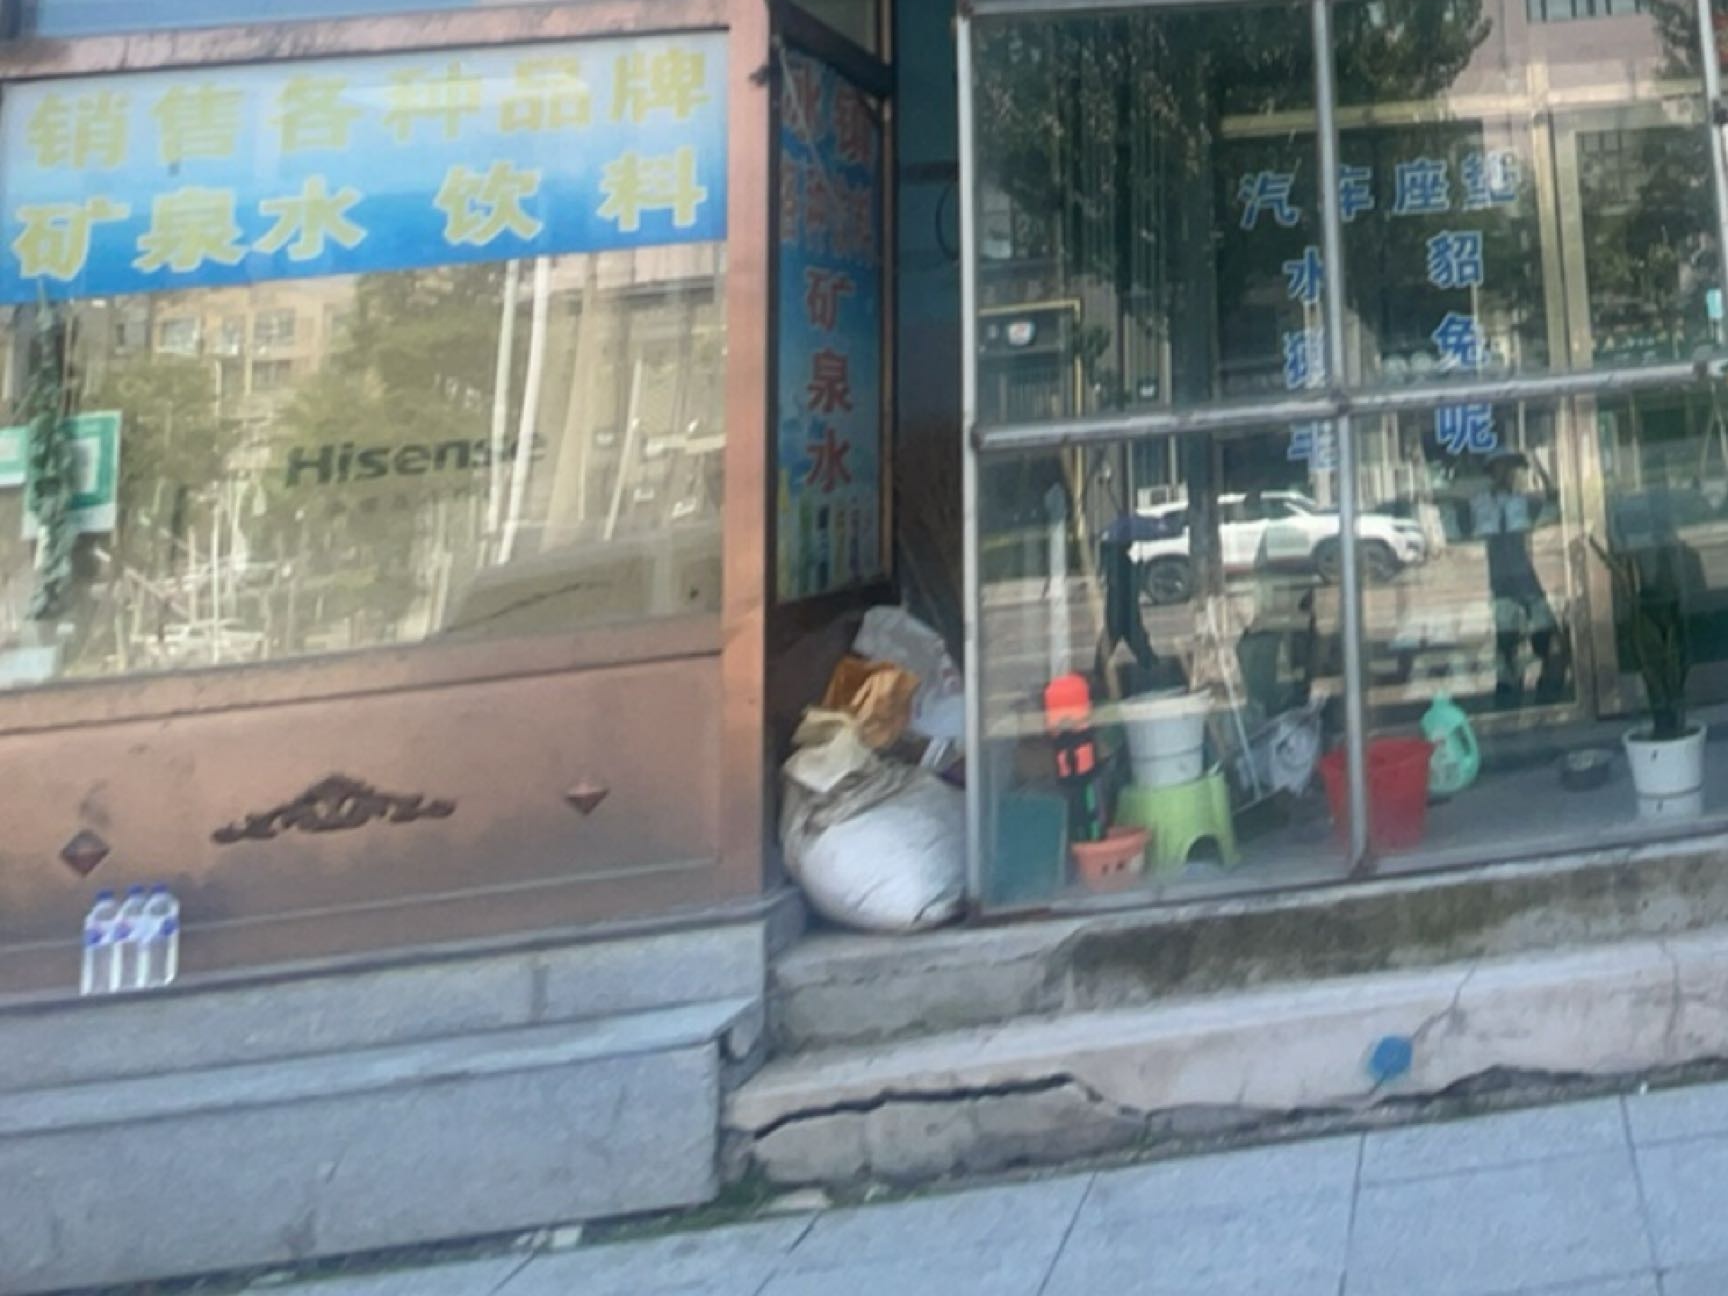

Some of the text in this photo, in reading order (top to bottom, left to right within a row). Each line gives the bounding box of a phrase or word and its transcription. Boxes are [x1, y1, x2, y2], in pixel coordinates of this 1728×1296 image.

[25, 49, 712, 171] 销售各种品牌
[12, 174, 368, 281] 矿泉水
[433, 144, 709, 248] 饮料
[803, 266, 856, 494] 矿泉水
